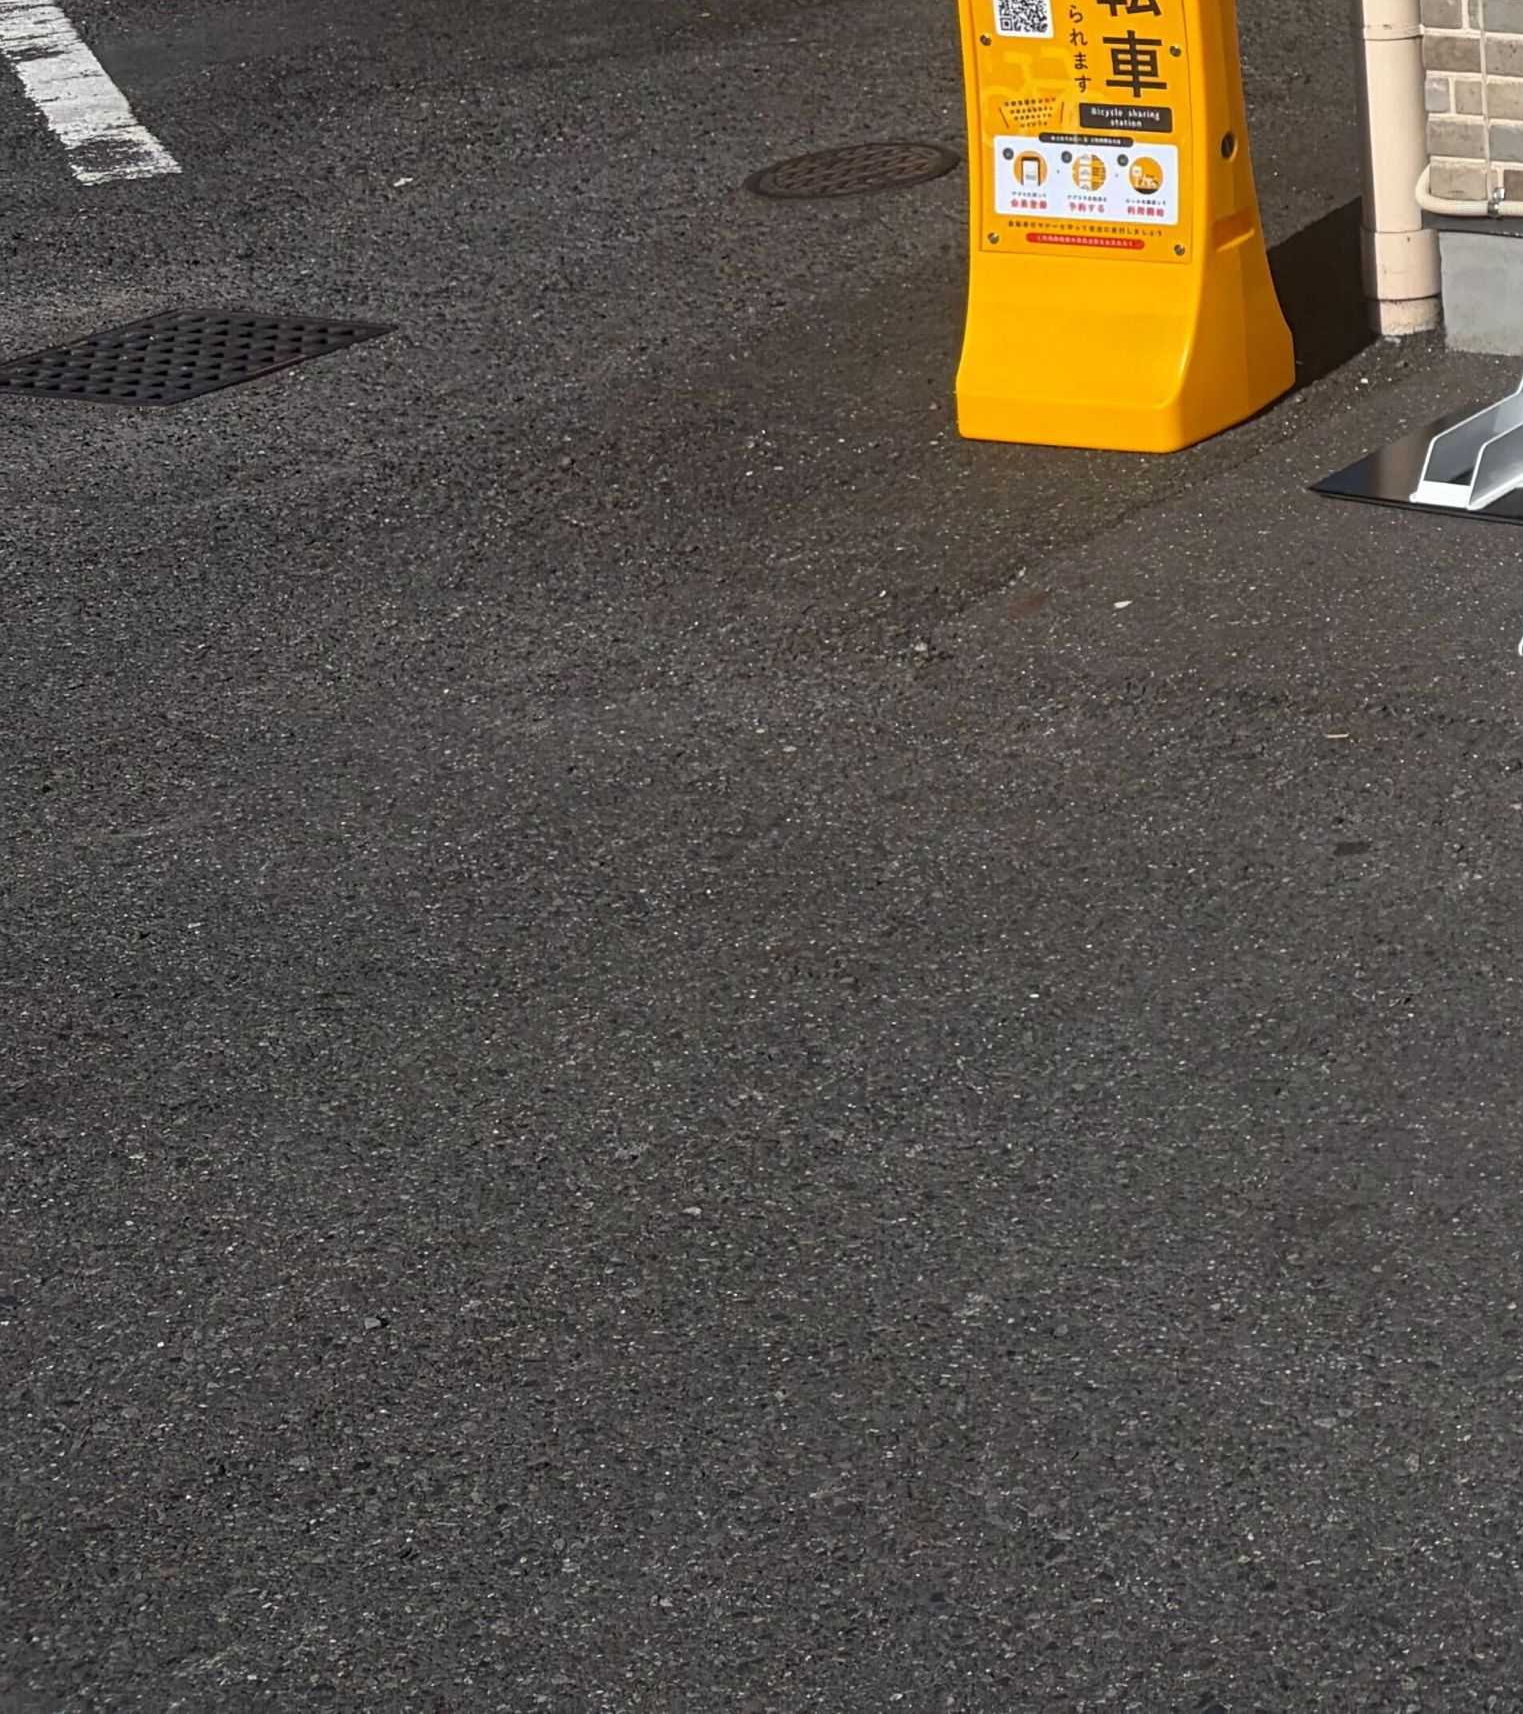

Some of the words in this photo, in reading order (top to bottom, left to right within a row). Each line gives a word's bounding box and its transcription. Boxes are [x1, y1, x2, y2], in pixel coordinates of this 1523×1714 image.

[1091, 106, 1124, 118] Bicycle
[1127, 109, 1161, 122] sharing
[1110, 118, 1143, 128] station
